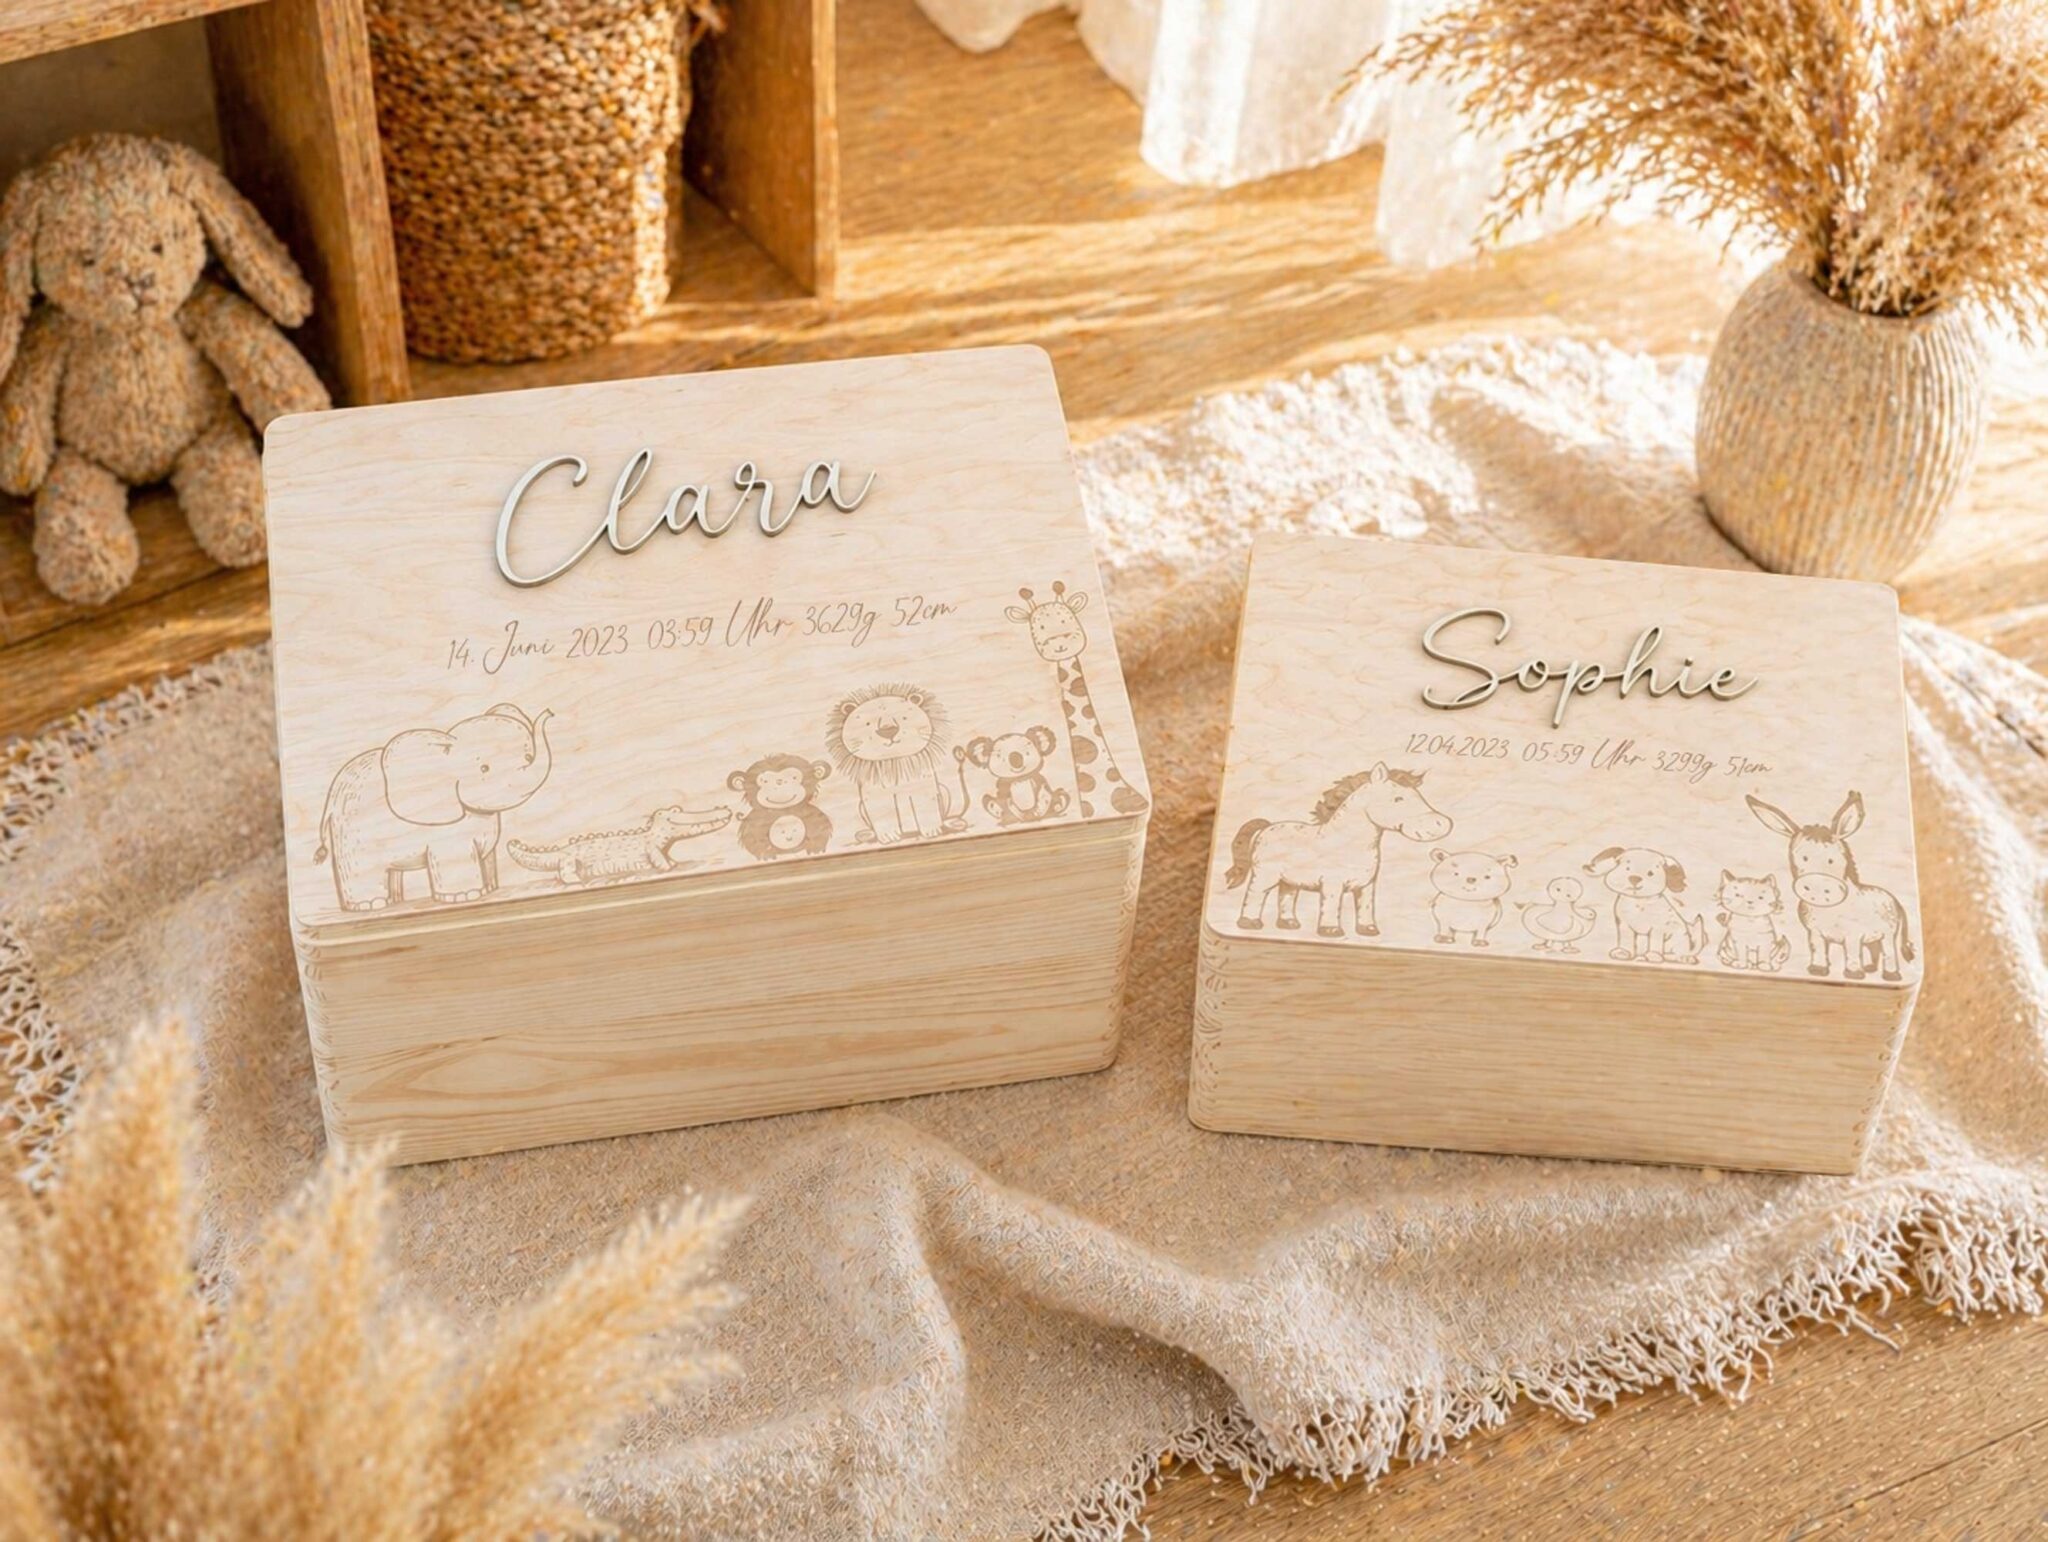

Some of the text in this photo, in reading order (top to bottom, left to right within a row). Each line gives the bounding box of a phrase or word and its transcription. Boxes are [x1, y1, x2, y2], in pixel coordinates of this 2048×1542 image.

[494, 447, 876, 588] Clara
[447, 595, 958, 675] 14. Juni 2023 03:59 Uhr 3629g 52cm
[1422, 607, 1759, 729] Sophie
[1522, 741, 1585, 765] 05:59
[1590, 737, 1647, 771] Uhr
[1652, 750, 1718, 784] 3299g
[1726, 755, 1773, 777] 51cm
